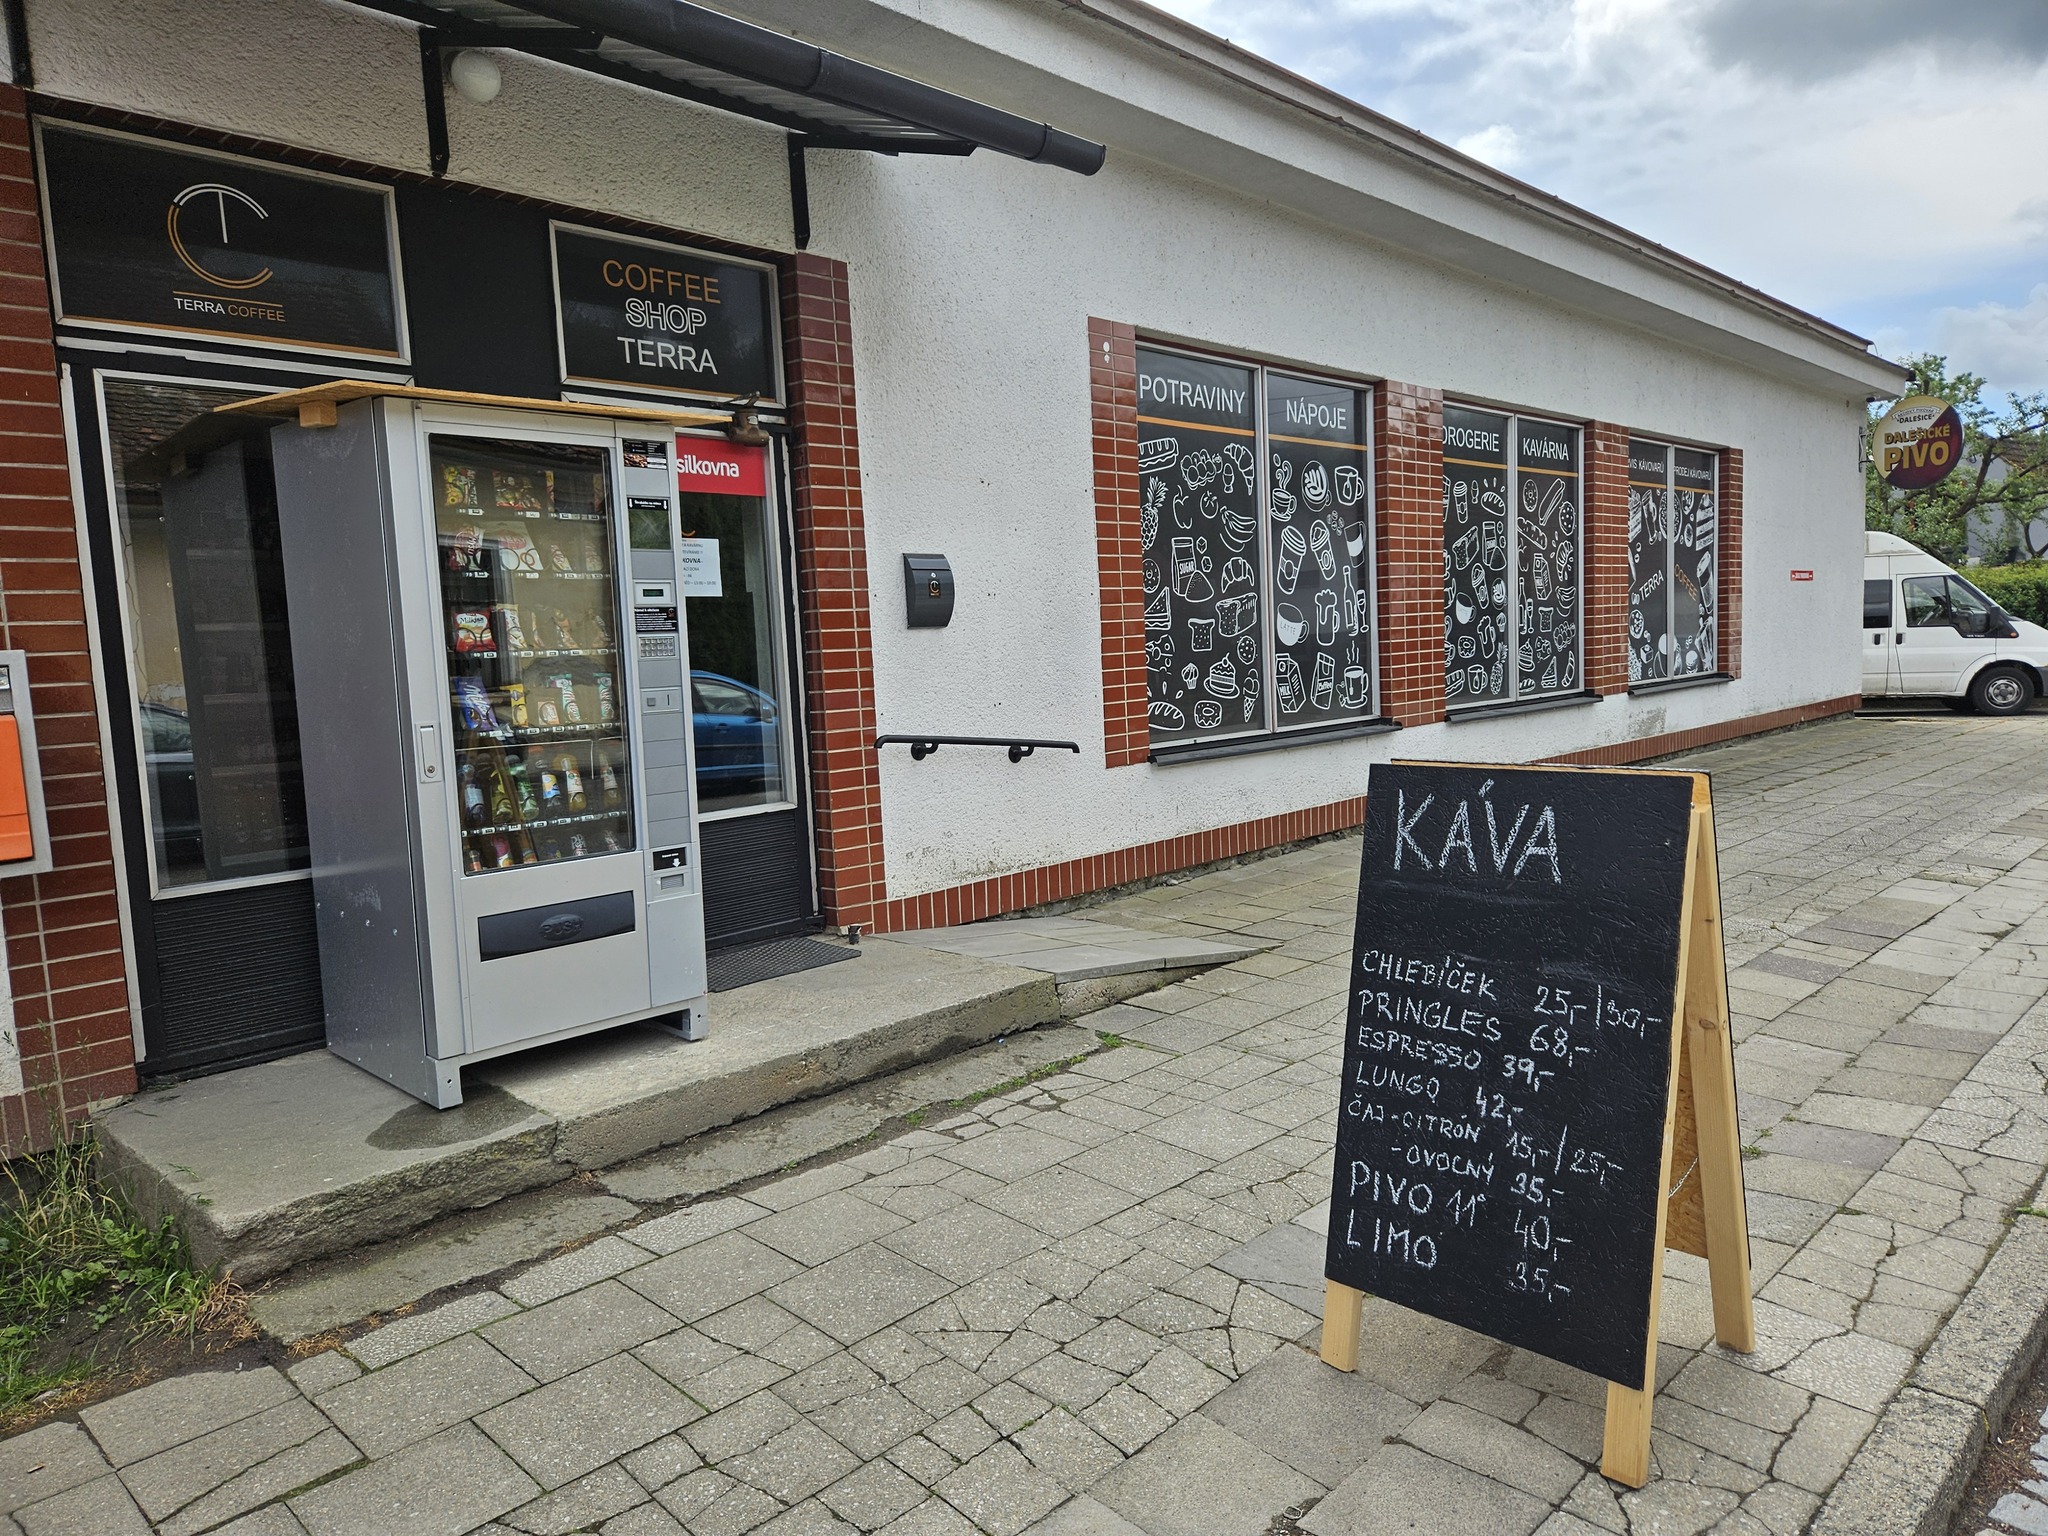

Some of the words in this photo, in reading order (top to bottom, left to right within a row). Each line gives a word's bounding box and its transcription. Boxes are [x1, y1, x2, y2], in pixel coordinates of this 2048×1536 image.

[603, 259, 721, 304] COFFEE
[174, 298, 225, 315] TERRA
[228, 305, 286, 322] COFFEE
[625, 298, 706, 335] SHOP
[617, 336, 718, 375] TERRA
[1139, 374, 1245, 414] POTRAVINY
[1286, 397, 1347, 430] NÁPOJE
[1523, 437, 1570, 461] KAVÁRNA
[1884, 423, 1951, 444] DALEŠICKÉ
[676, 455, 740, 478] silkovna
[1884, 440, 1950, 472] PIVO
[1639, 569, 1664, 601] TERRA
[1674, 563, 1698, 601] COFFEE
[1393, 779, 1562, 884] KÁVA
[1362, 950, 1497, 1001] CHLEBÍČEK
[1358, 989, 1502, 1042] PRINGLES
[1358, 1025, 1482, 1071] ESPRESSO
[1356, 1061, 1440, 1102] LUNGO
[1350, 1160, 1433, 1215] PIVO
[1346, 1208, 1438, 1270] LIMO
